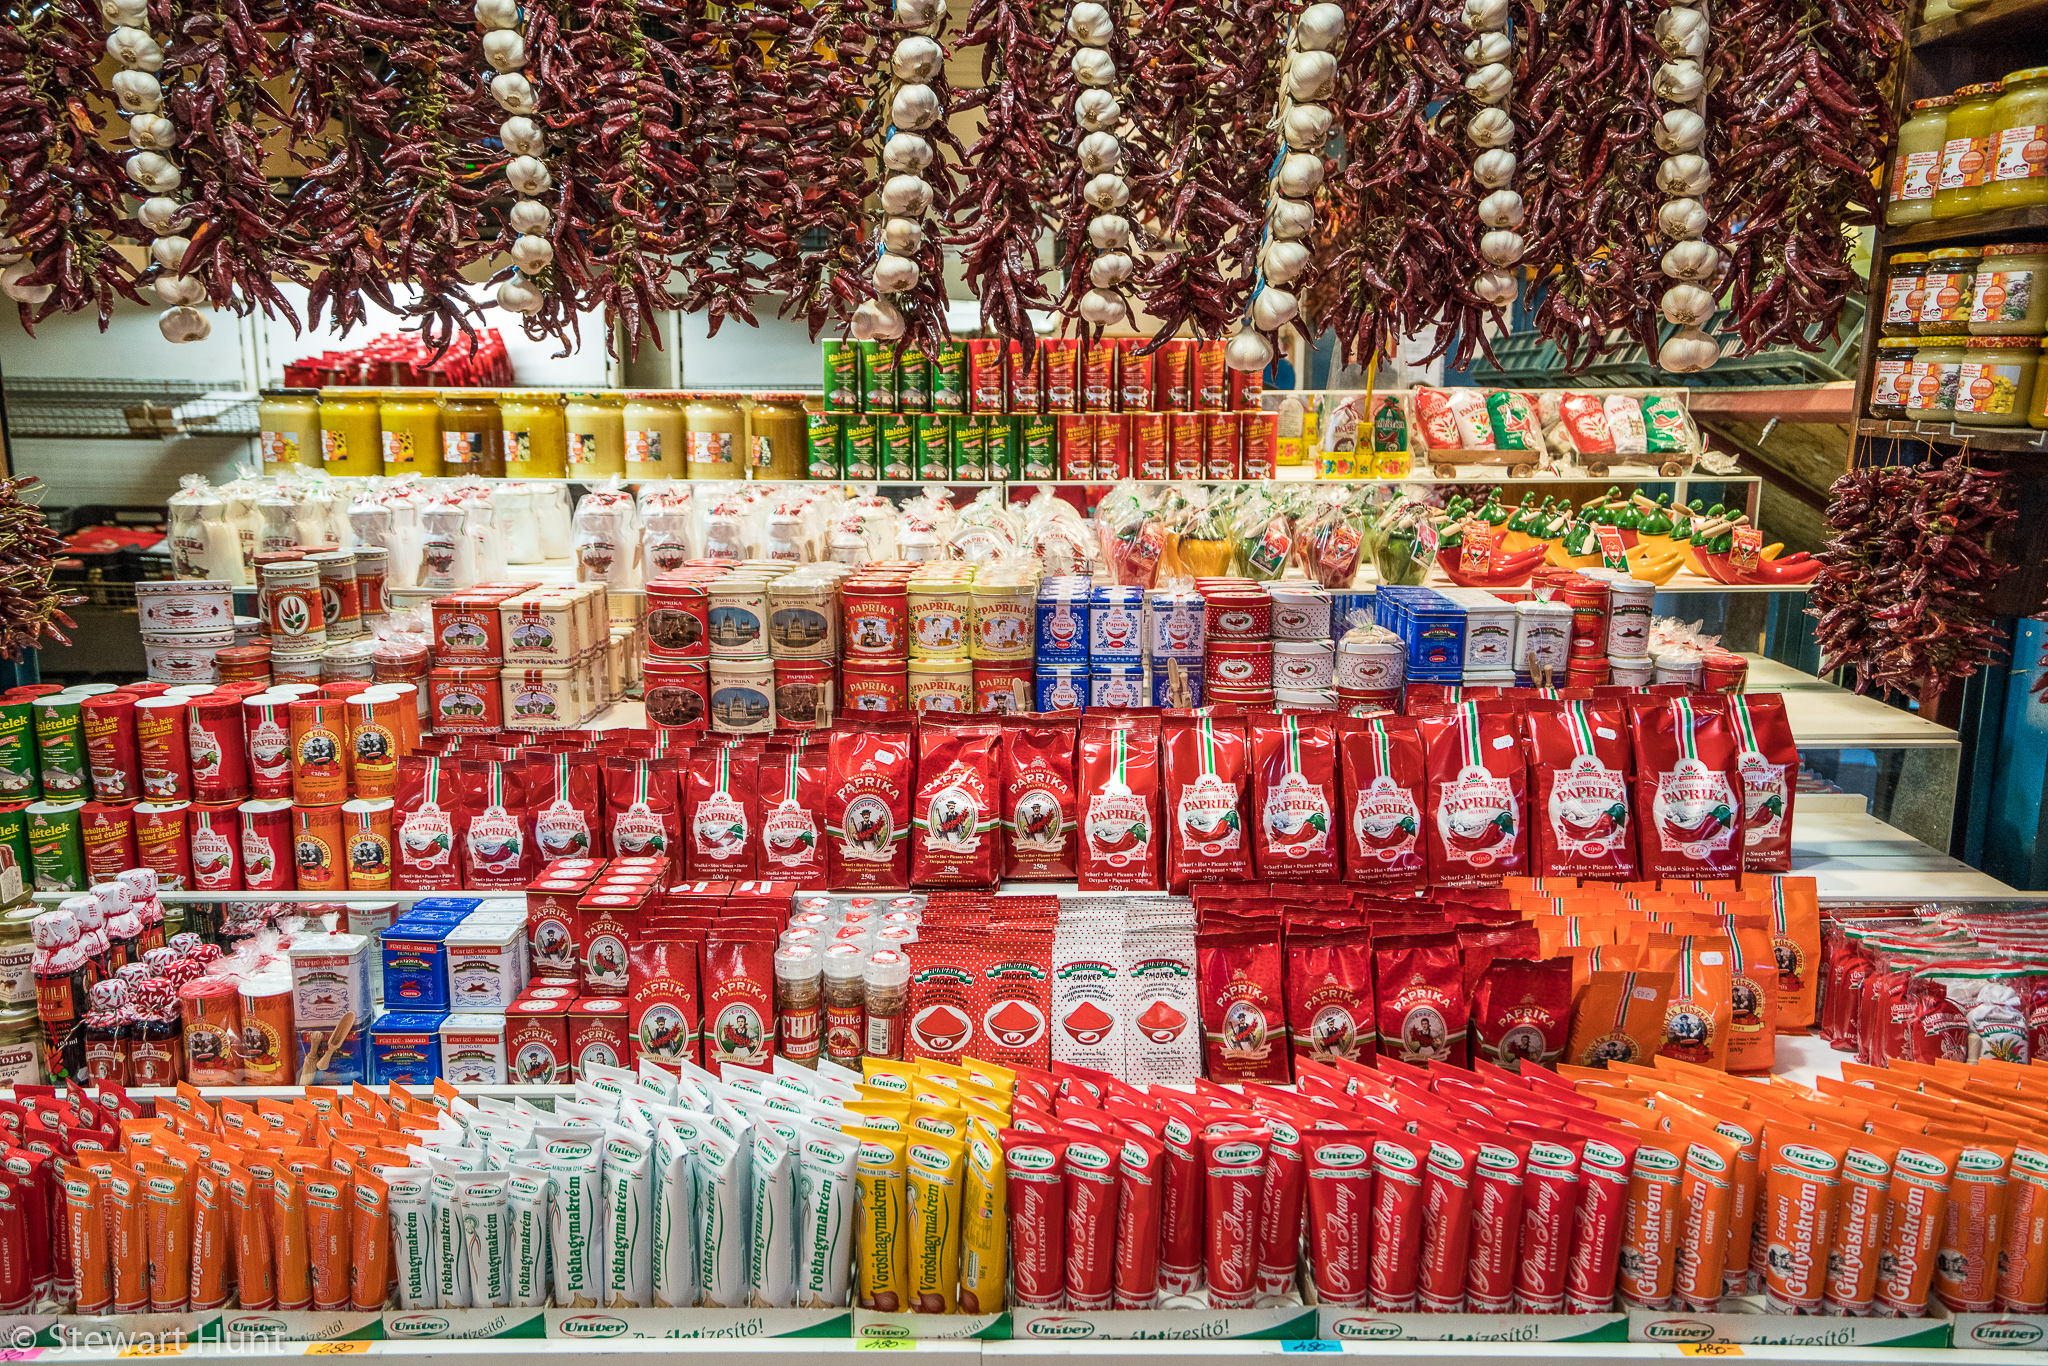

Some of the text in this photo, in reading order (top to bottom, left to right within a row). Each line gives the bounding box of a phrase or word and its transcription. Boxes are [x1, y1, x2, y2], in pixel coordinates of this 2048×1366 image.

[850, 604, 895, 615] PAPRIKA
[915, 602, 962, 613] PAPRIKA
[981, 604, 1027, 615] PAPRIKA
[850, 682, 895, 693] PAPRIKA
[915, 681, 963, 692] PAPRIKA
[837, 777, 901, 801] PAPRIKA
[924, 772, 985, 794] PAPRIKA
[1009, 773, 1068, 794] PAPRIKA
[1556, 786, 1625, 802] PAPRIKA
[1660, 789, 1729, 804] PAPRIKA
[1183, 799, 1238, 812] PAPRIKA
[1268, 801, 1324, 815] PAPRIKA
[1359, 803, 1414, 819] PAPRIKA
[1443, 796, 1512, 815] PAPRIKA
[697, 813, 744, 824] PAPRIKA
[768, 821, 813, 831] PAPRIKA
[1090, 810, 1146, 823] PAPRIKA
[404, 823, 449, 834] PAPRIKA
[471, 828, 518, 839] PAPRIKA
[538, 823, 585, 833] PAPRIKA
[616, 825, 663, 836] PAPRIKA
[861, 873, 876, 881] 250g
[530, 907, 573, 925] PAPRIKA
[584, 923, 629, 939] PAPRIKA
[928, 967, 961, 975] HUNGARY
[1000, 962, 1032, 970] HUNGARY
[1143, 960, 1175, 968] HUNGARY
[928, 977, 958, 986] SMOKED
[1000, 972, 1031, 981] SMOKED
[1072, 973, 1102, 981] SMOKED
[1144, 971, 1174, 979] SMOKED
[635, 982, 691, 1003] PAPRIKA
[711, 982, 768, 1002] PAPRIKA
[1216, 982, 1269, 1008] PAPRIKA
[1303, 988, 1361, 1011] PAPRIKA
[1392, 988, 1451, 1013] PAPRIKA
[828, 1011, 861, 1026] Paprika
[1498, 1007, 1556, 1030] PAPRIKA
[512, 1030, 559, 1047] PAPRIKA
[575, 1031, 621, 1047] PAPRIKA
[871, 1078, 906, 1090] Univer
[918, 1121, 954, 1135] Univer
[549, 1144, 591, 1156] Univer
[608, 1143, 641, 1160] Univer
[701, 1144, 726, 1163] Univer
[757, 1140, 777, 1162] Univer
[807, 1144, 844, 1162] Univer
[858, 1148, 894, 1162] Univer
[912, 1148, 950, 1168] Univer
[973, 1142, 991, 1170] Univer
[1009, 1152, 1054, 1166] Univer
[1066, 1148, 1109, 1166] Univer
[1216, 1148, 1260, 1159] Univer
[1318, 1150, 1364, 1160] Univer
[1376, 1146, 1416, 1165] Univer
[1785, 1148, 1835, 1167] Univer
[1897, 1150, 1946, 1172] Univer
[1626, 1200, 1636, 1242] Eredeti
[1664, 1209, 1673, 1244] CSEMEGE
[1706, 1210, 1716, 1244] CSEMEGE
[1775, 1194, 1789, 1241] Eredeti
[566, 1176, 585, 1291] Fokhagymakrém
[611, 1178, 630, 1291] Fokhagymakrém
[702, 1181, 715, 1292] Fokhagymakrém
[751, 1178, 766, 1289] Fokhagymakrém
[809, 1179, 832, 1292] Fokhagymakrém
[871, 1179, 891, 1290] Vöröshagymakrém
[1066, 1182, 1096, 1292] Piros Arany
[1221, 1182, 1252, 1290] Piros Arany
[1371, 1182, 1402, 1290] Piros Arany
[1522, 1181, 1560, 1293] Piros Arany
[1568, 1179, 1608, 1292] Piros Arany
[1817, 1210, 1827, 1245] CSEMEGE
[1868, 1214, 1878, 1248] CSEMEGE
[1923, 1215, 1935, 1250] CSEMEGE
[919, 1183, 940, 1292] Vöröshagymakrém
[1017, 1184, 1044, 1293] Piros Arany
[1326, 1183, 1356, 1292] Piros Arany
[1636, 1184, 1662, 1295] Gulyáskrém
[1677, 1182, 1707, 1293] Gulyáskrém
[1785, 1183, 1817, 1297] Gulyáskrém
[1835, 1186, 1869, 1299] Gulyáskrém
[1888, 1187, 1925, 1300] Gulyáskrém
[406, 1212, 422, 1299] Fokhagymakrém
[442, 1208, 453, 1296] Fokhagymakrém
[487, 1213, 501, 1299] Fokhagymakrém
[518, 1210, 532, 1298] Fokhagymakrém
[564, 1322, 627, 1333] Univer
[863, 1328, 908, 1337] Univer
[1033, 1324, 1090, 1336] Univer
[1338, 1324, 1399, 1336] Univer
[1650, 1325, 1711, 1337] Univer
[1977, 1327, 2039, 1340] Univer
